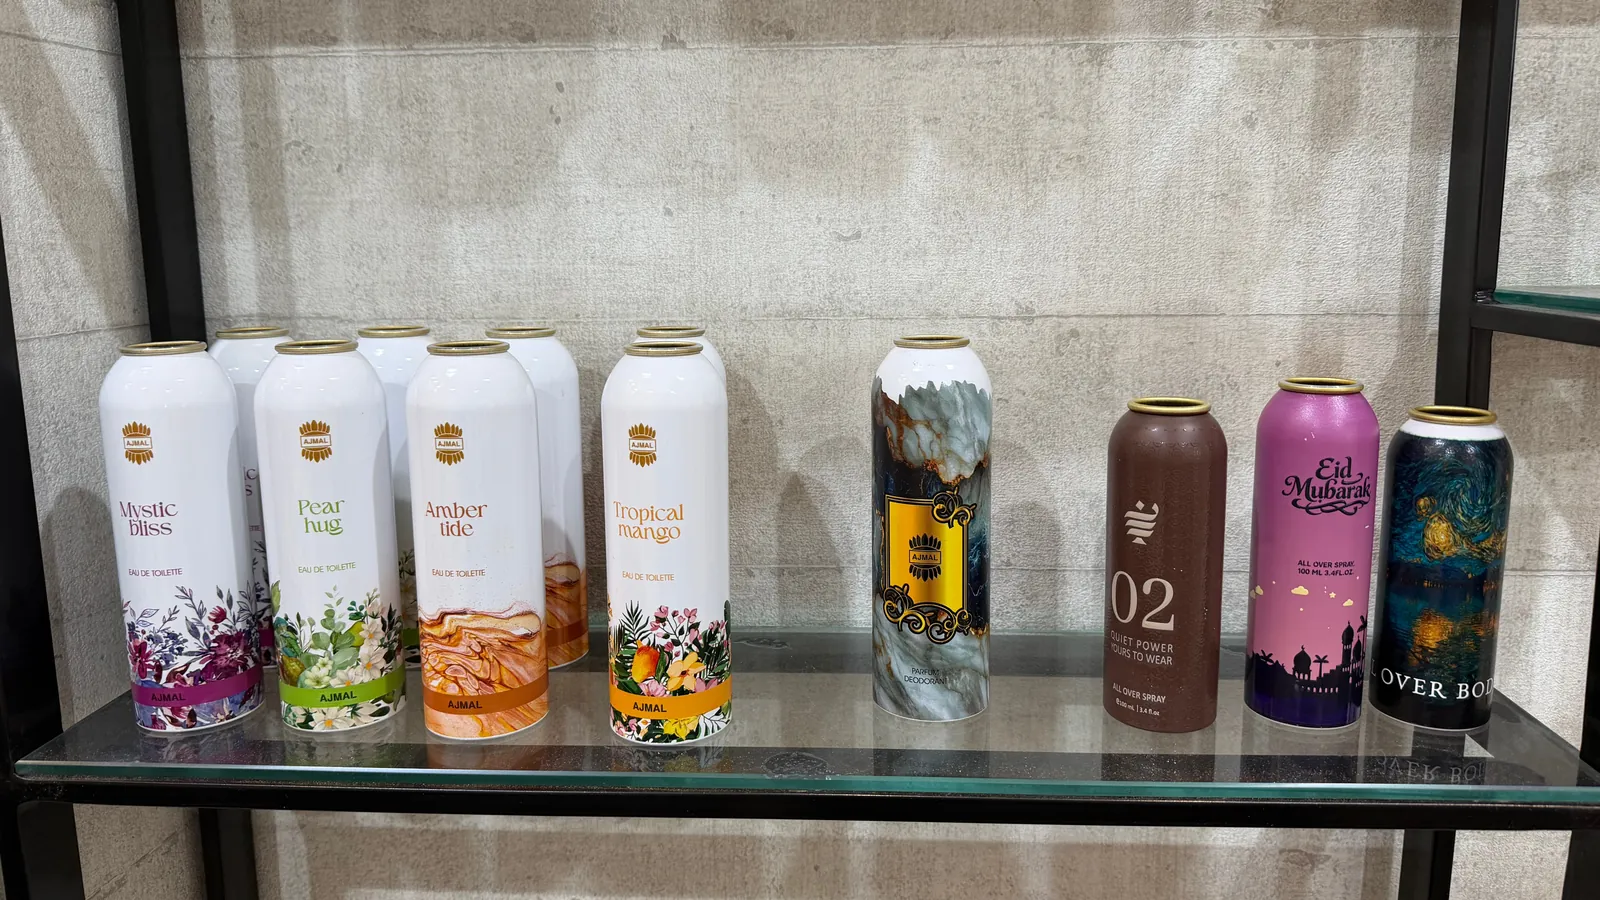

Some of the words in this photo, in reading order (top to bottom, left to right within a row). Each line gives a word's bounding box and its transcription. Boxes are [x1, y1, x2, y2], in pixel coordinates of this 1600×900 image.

[126, 439, 149, 447] AJMAL
[303, 437, 328, 445] AJMAL
[437, 440, 460, 448] AJMAL
[631, 441, 653, 449] AJMAL
[1315, 456, 1352, 480] Eid
[1281, 474, 1371, 512] Mubarak
[119, 501, 178, 522] Mystic
[298, 499, 345, 515] Pear
[425, 501, 488, 519] Amber
[613, 500, 684, 525] Tropical
[129, 519, 172, 536] bliss
[304, 517, 343, 536] hug
[440, 520, 474, 537] tide
[618, 523, 681, 545] mango
[912, 553, 938, 562] AJMAL
[1297, 559, 1311, 567] ALL
[128, 568, 140, 576] EAU
[140, 569, 150, 577] DE
[151, 568, 182, 577] TOILETTE
[298, 566, 312, 574] EAU
[313, 565, 324, 573] DE
[326, 562, 356, 572] TOILETTE
[432, 568, 444, 577] EAU
[444, 570, 454, 578] DE
[456, 569, 486, 578] TOILETTE
[622, 571, 634, 580] EAU
[634, 573, 644, 581] DE
[645, 573, 675, 582] TOILETTE
[1111, 570, 1175, 631] 02
[1110, 630, 1133, 646] QUIET
[1136, 639, 1173, 653] POWER
[1110, 641, 1131, 659] YOURS
[1132, 650, 1144, 662] TO
[1145, 653, 1173, 666] WEAR
[911, 667, 940, 676] PARFUM
[903, 675, 948, 685] DEODORANT
[1380, 667, 1447, 699] OVER
[150, 692, 187, 703] AJMAL
[319, 690, 357, 703] AJMAL
[1112, 682, 1122, 693] ALL
[1122, 687, 1141, 699] OVER
[1142, 692, 1166, 703] SPRAY
[447, 699, 483, 710] AJMAL
[632, 701, 667, 713] AJMAL
